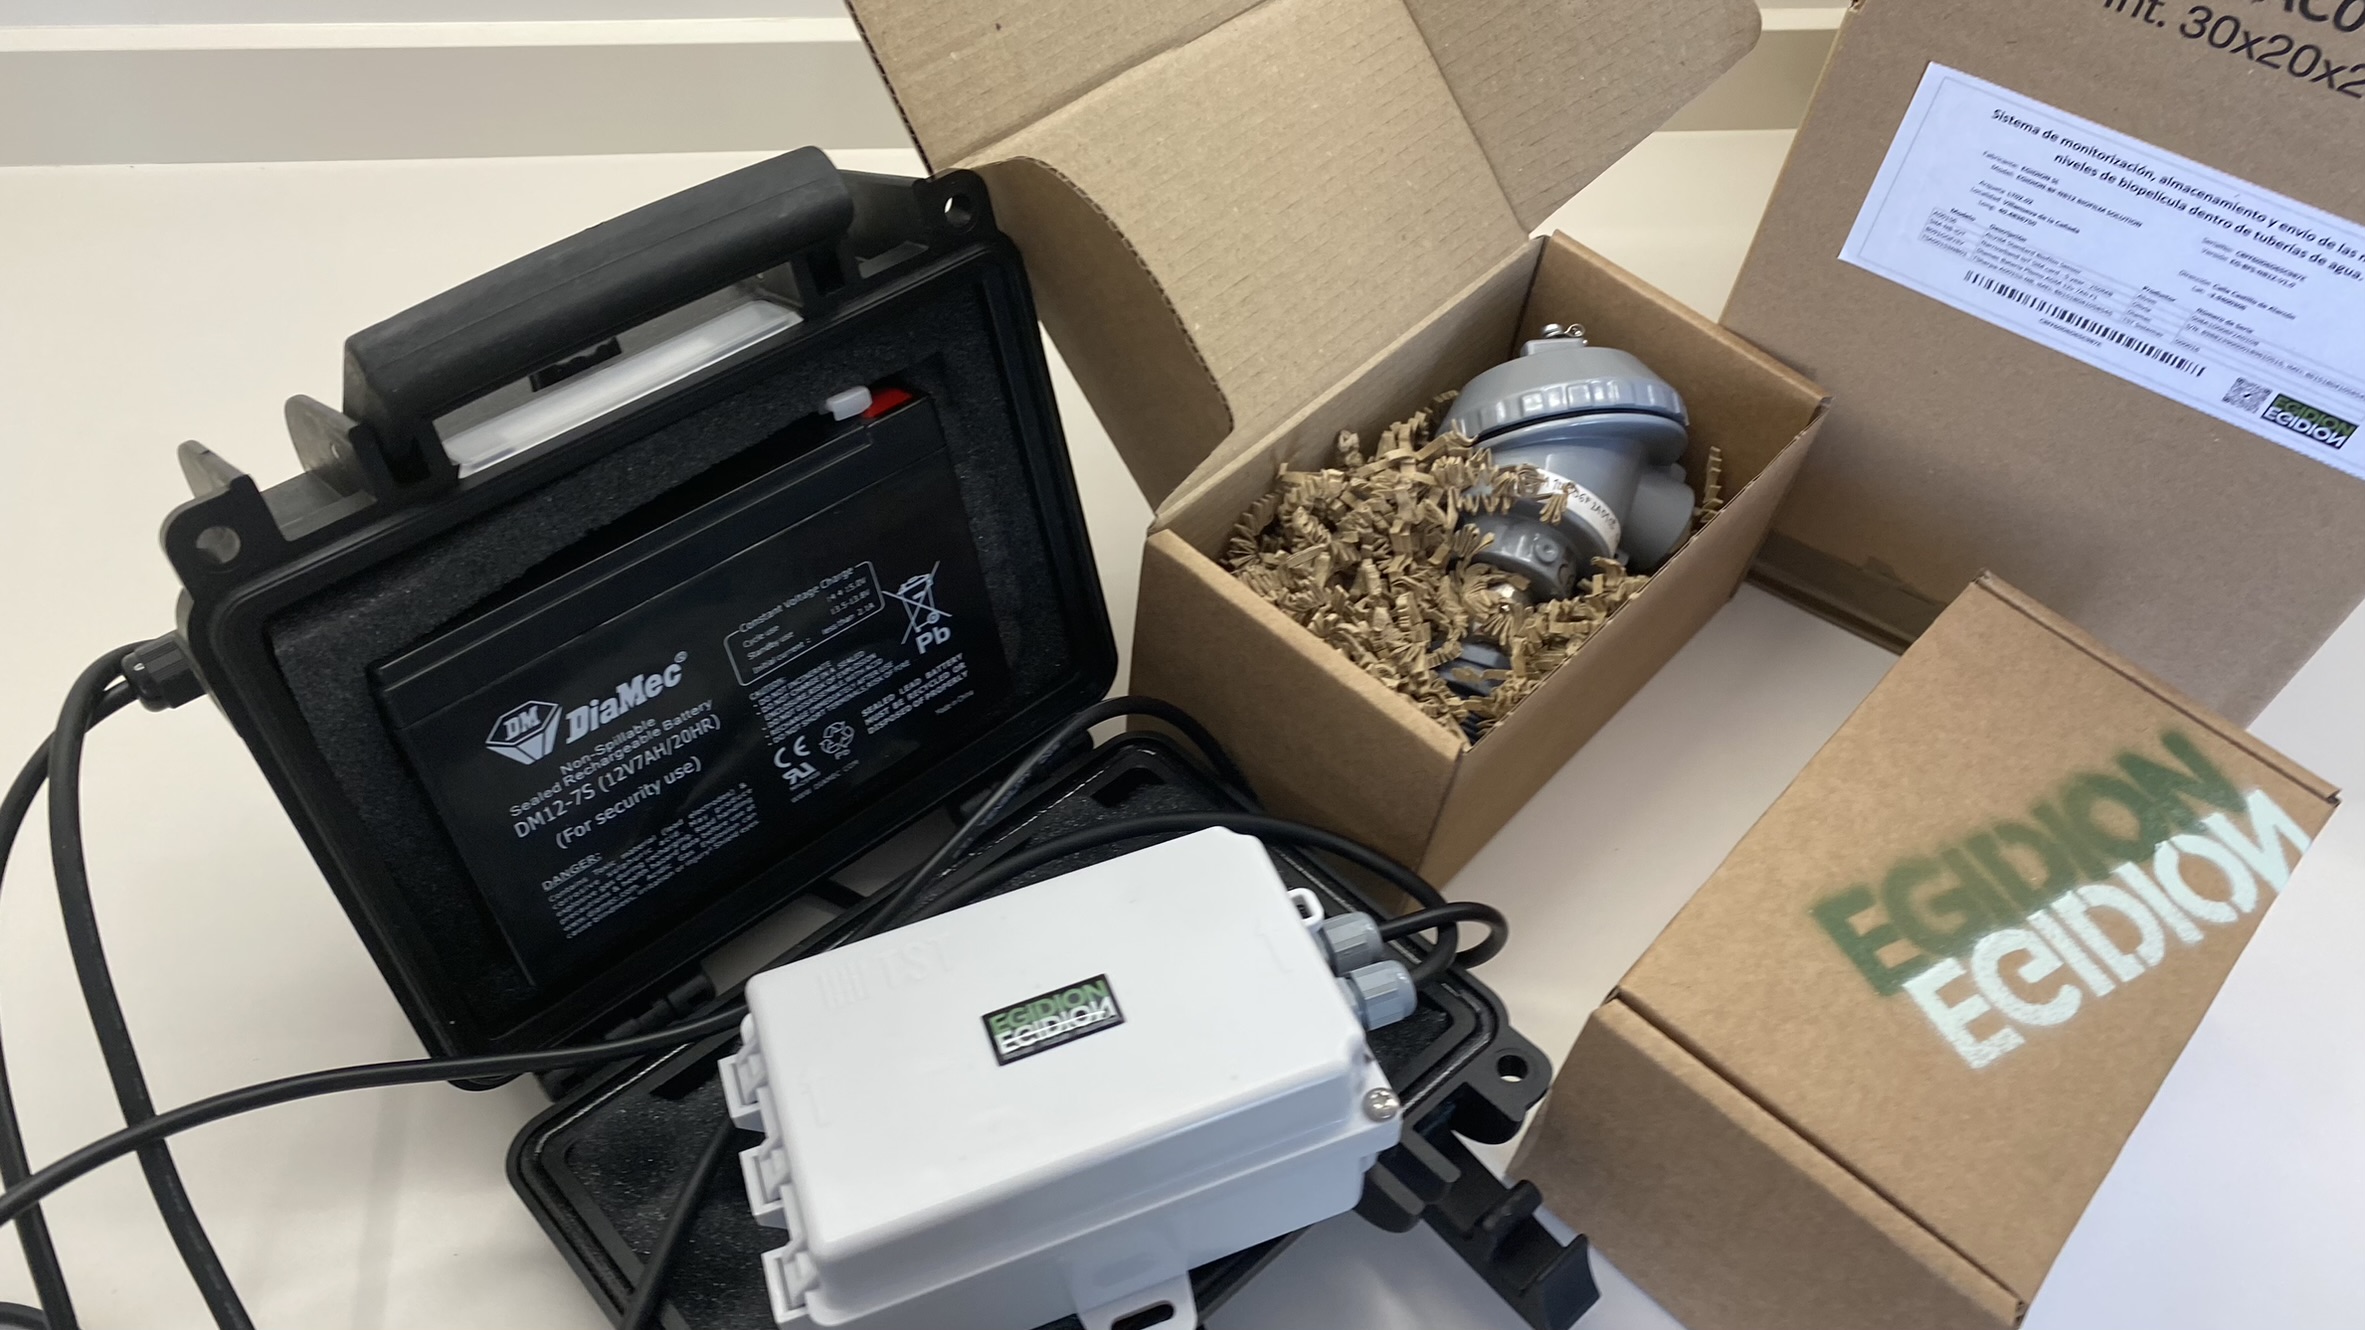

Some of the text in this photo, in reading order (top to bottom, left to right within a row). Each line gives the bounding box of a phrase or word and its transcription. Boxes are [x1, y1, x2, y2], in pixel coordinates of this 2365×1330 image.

[1992, 109, 2360, 256] Sistema de monitorización, almacenamiento y envío de las
[2055, 154, 2098, 176] niveles
[2100, 171, 2116, 183] de
[2117, 178, 2187, 213] biopelícula
[2188, 205, 2233, 229] dentro
[2234, 223, 2253, 236] de
[2253, 230, 2310, 258] tuberías
[2309, 252, 2329, 265] de
[2273, 397, 2355, 435] EGIDION
[739, 567, 853, 632] Constant Voltage Charge
[915, 625, 952, 656] Pb
[861, 652, 963, 717] SEALED LEAD BATTERY
[865, 662, 967, 726] MUST BE RECYCLED OR
[868, 670, 968, 735] DISPOSED OF PROPERLY
[502, 707, 542, 740] DM
[560, 717, 657, 775] Non-Spillable
[509, 699, 713, 816] Sealed Rechargeable Battery
[514, 713, 721, 838] DM12-7S (12V7AH/20HR)
[554, 755, 702, 849] (For security use)
[542, 851, 602, 891] DANGER:
[1806, 728, 2248, 997] EGIDION
[990, 980, 1109, 1034] EGIDION
